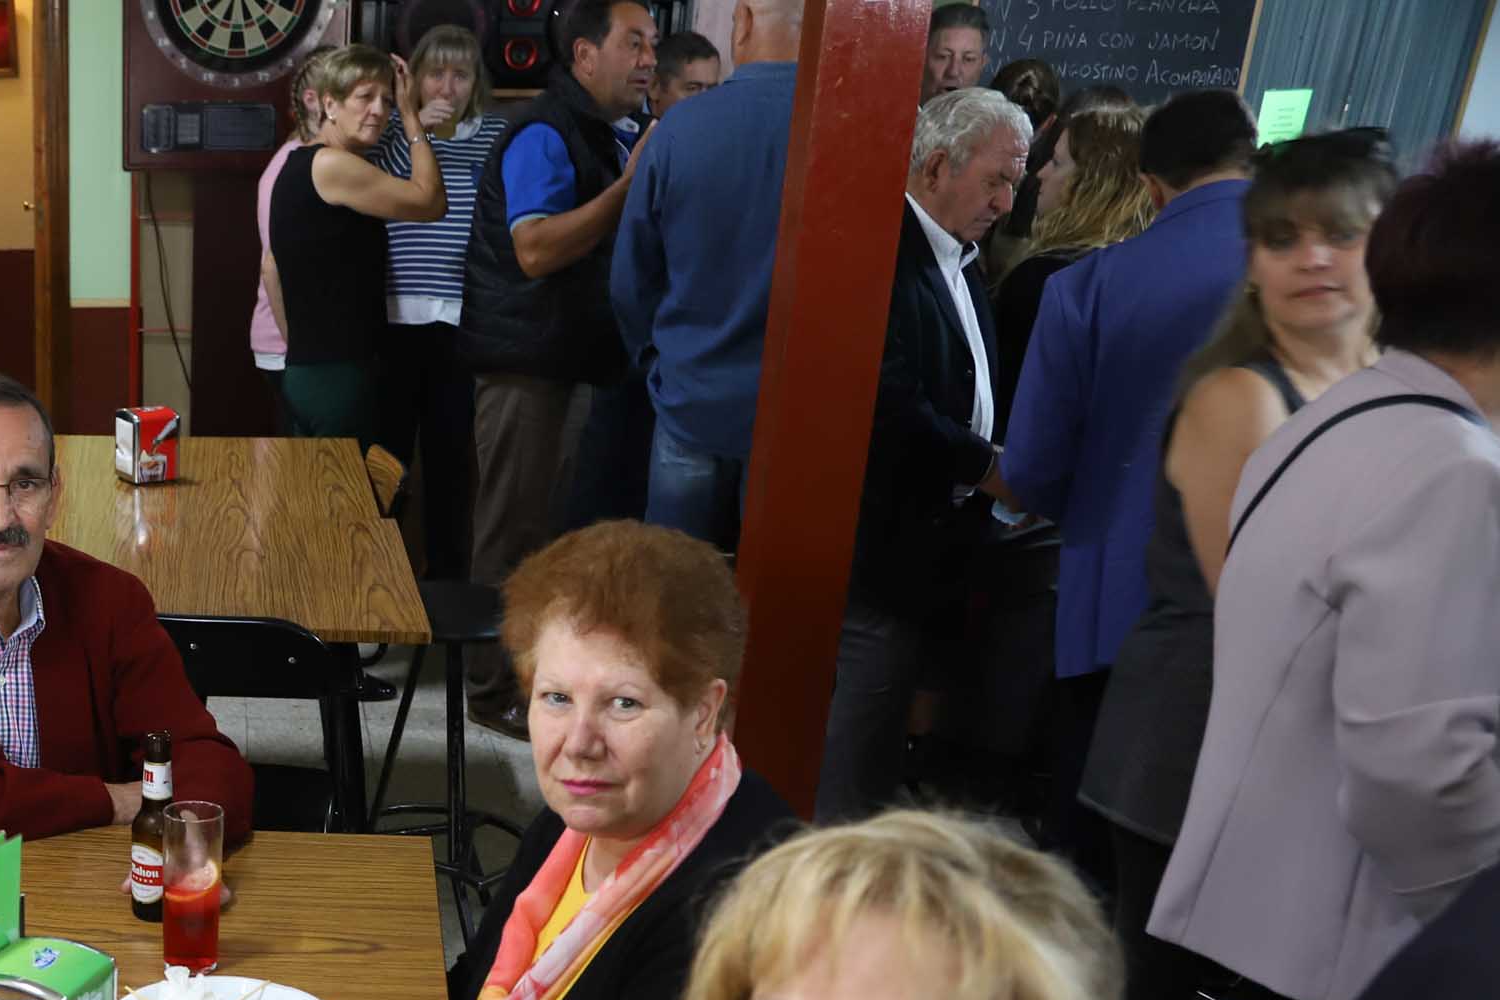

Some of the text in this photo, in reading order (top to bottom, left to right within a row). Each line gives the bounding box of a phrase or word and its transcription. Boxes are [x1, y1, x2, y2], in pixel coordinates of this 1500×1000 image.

[1018, 24, 1034, 53] 4
[1042, 23, 1089, 49] PIÑA
[1098, 31, 1136, 49] CON
[1147, 26, 1221, 51] JAMON
[1145, 58, 1240, 86] ACOMPAÑADO
